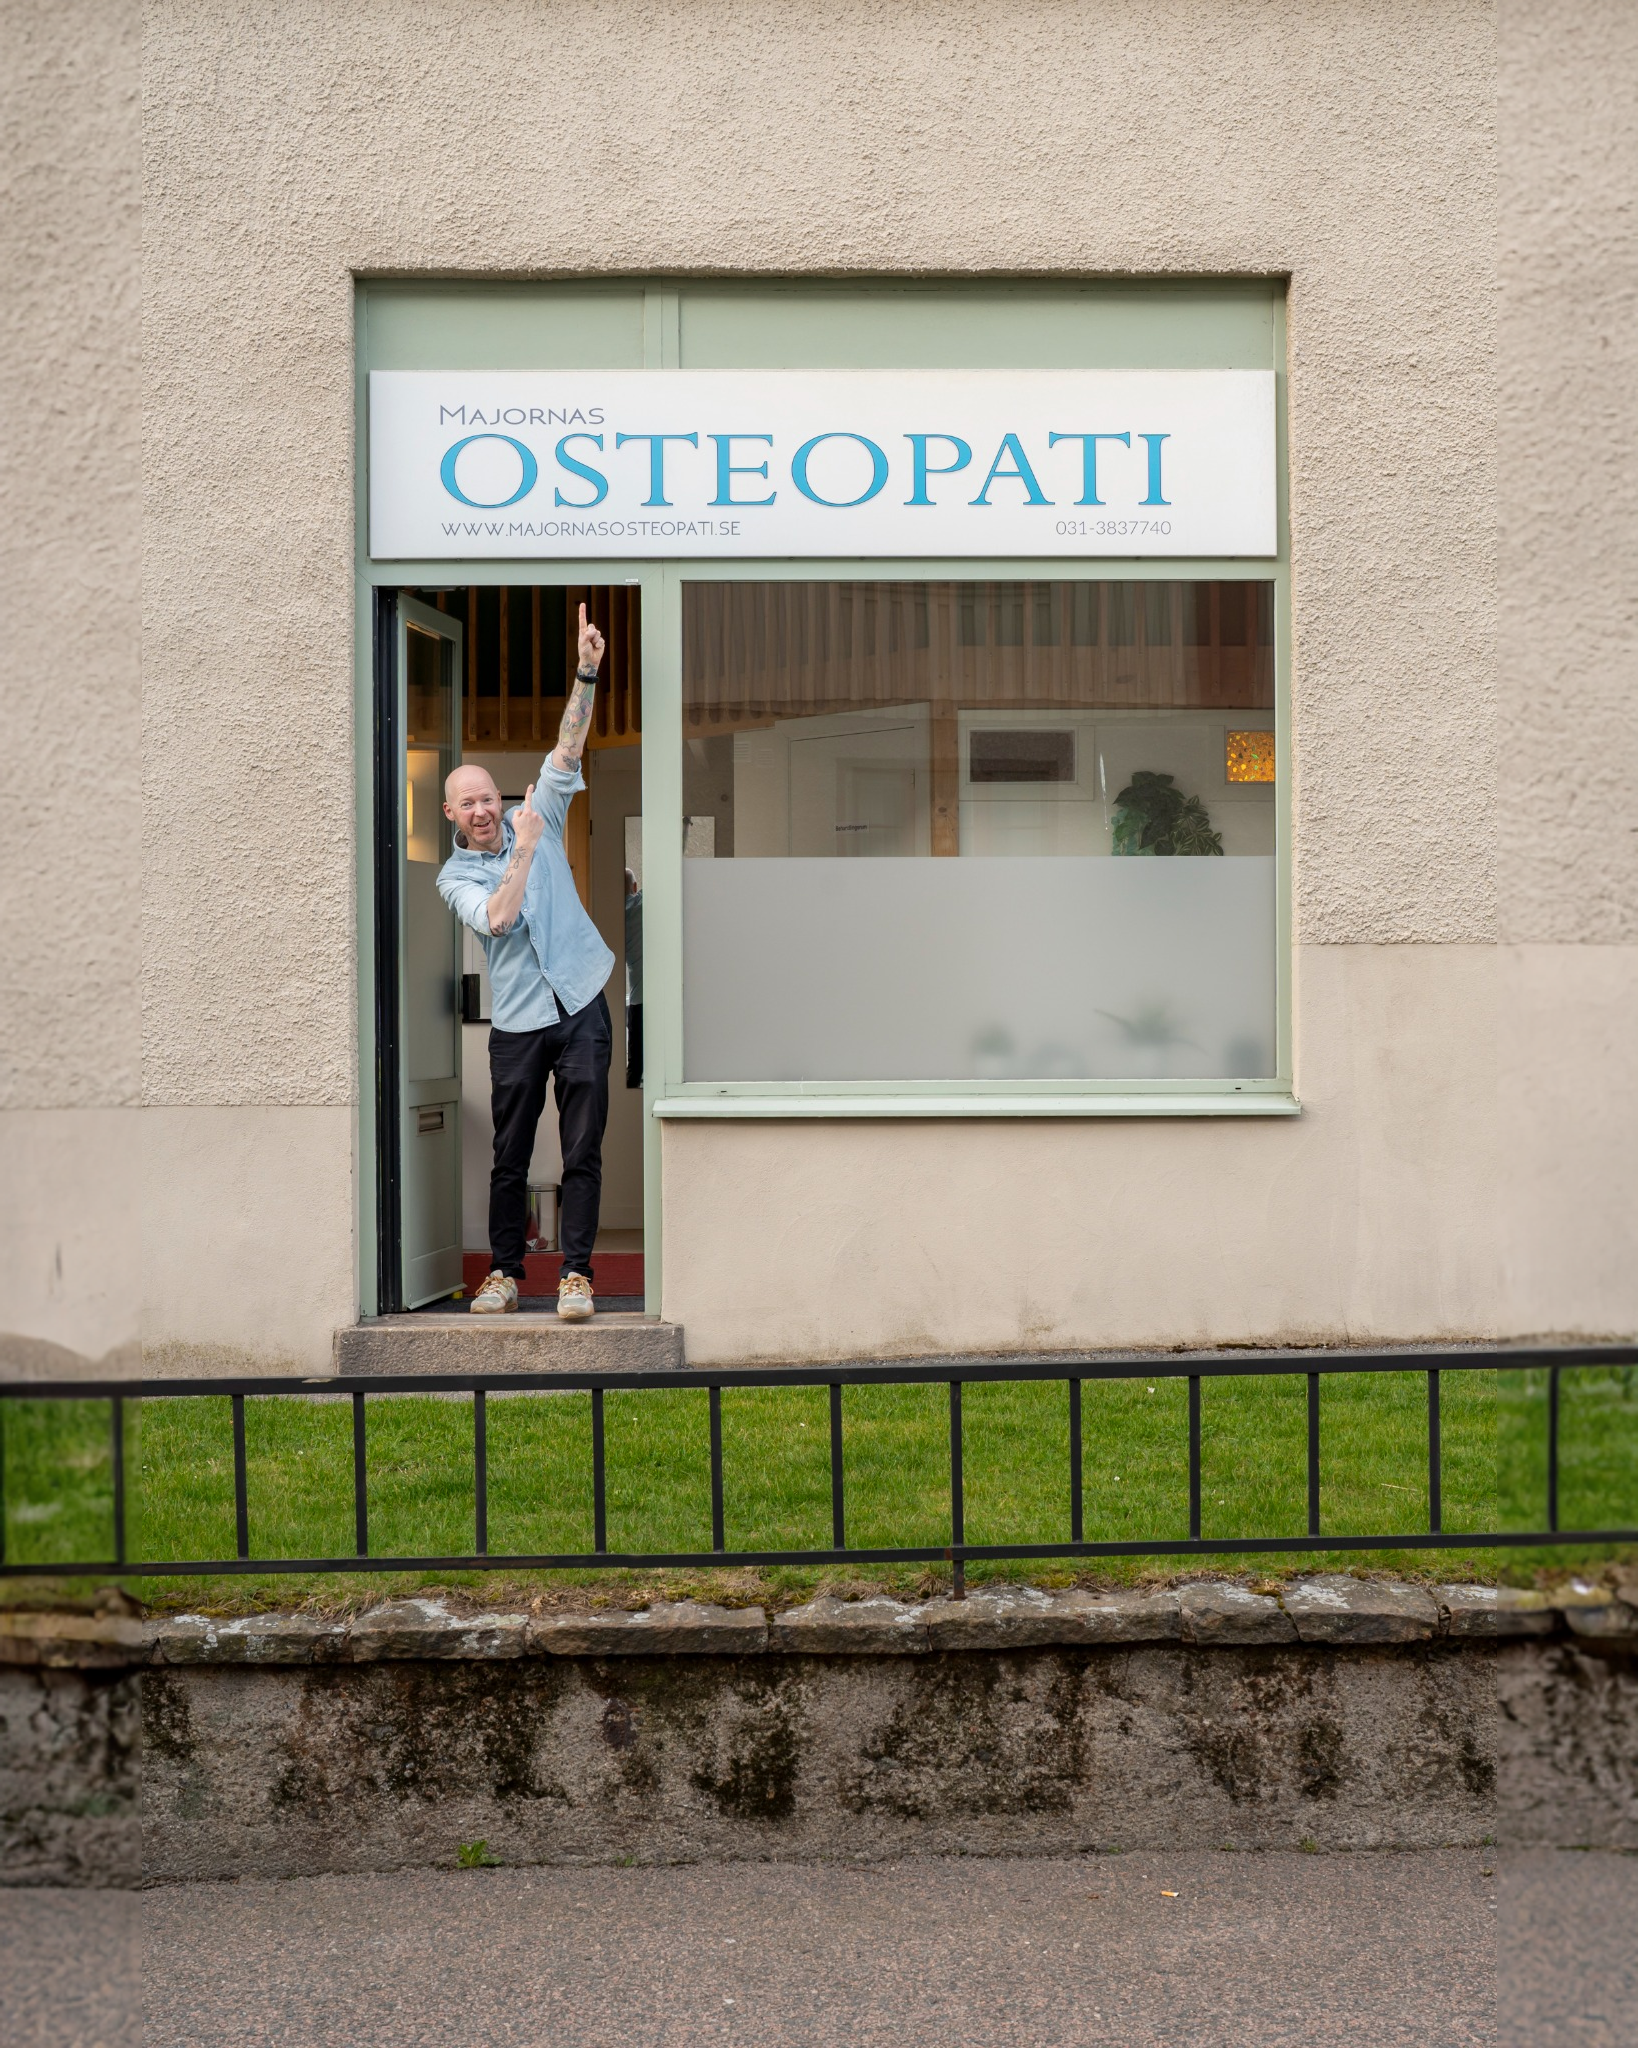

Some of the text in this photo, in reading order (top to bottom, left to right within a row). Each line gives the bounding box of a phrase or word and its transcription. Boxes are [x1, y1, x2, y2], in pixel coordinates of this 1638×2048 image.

[439, 404, 605, 426] MAJORNAS
[439, 431, 1172, 509] OSTEOPATI
[441, 521, 741, 537] WWW.MAJORNASOSTEOPATI.SE
[1055, 520, 1172, 536] 031-3837740
